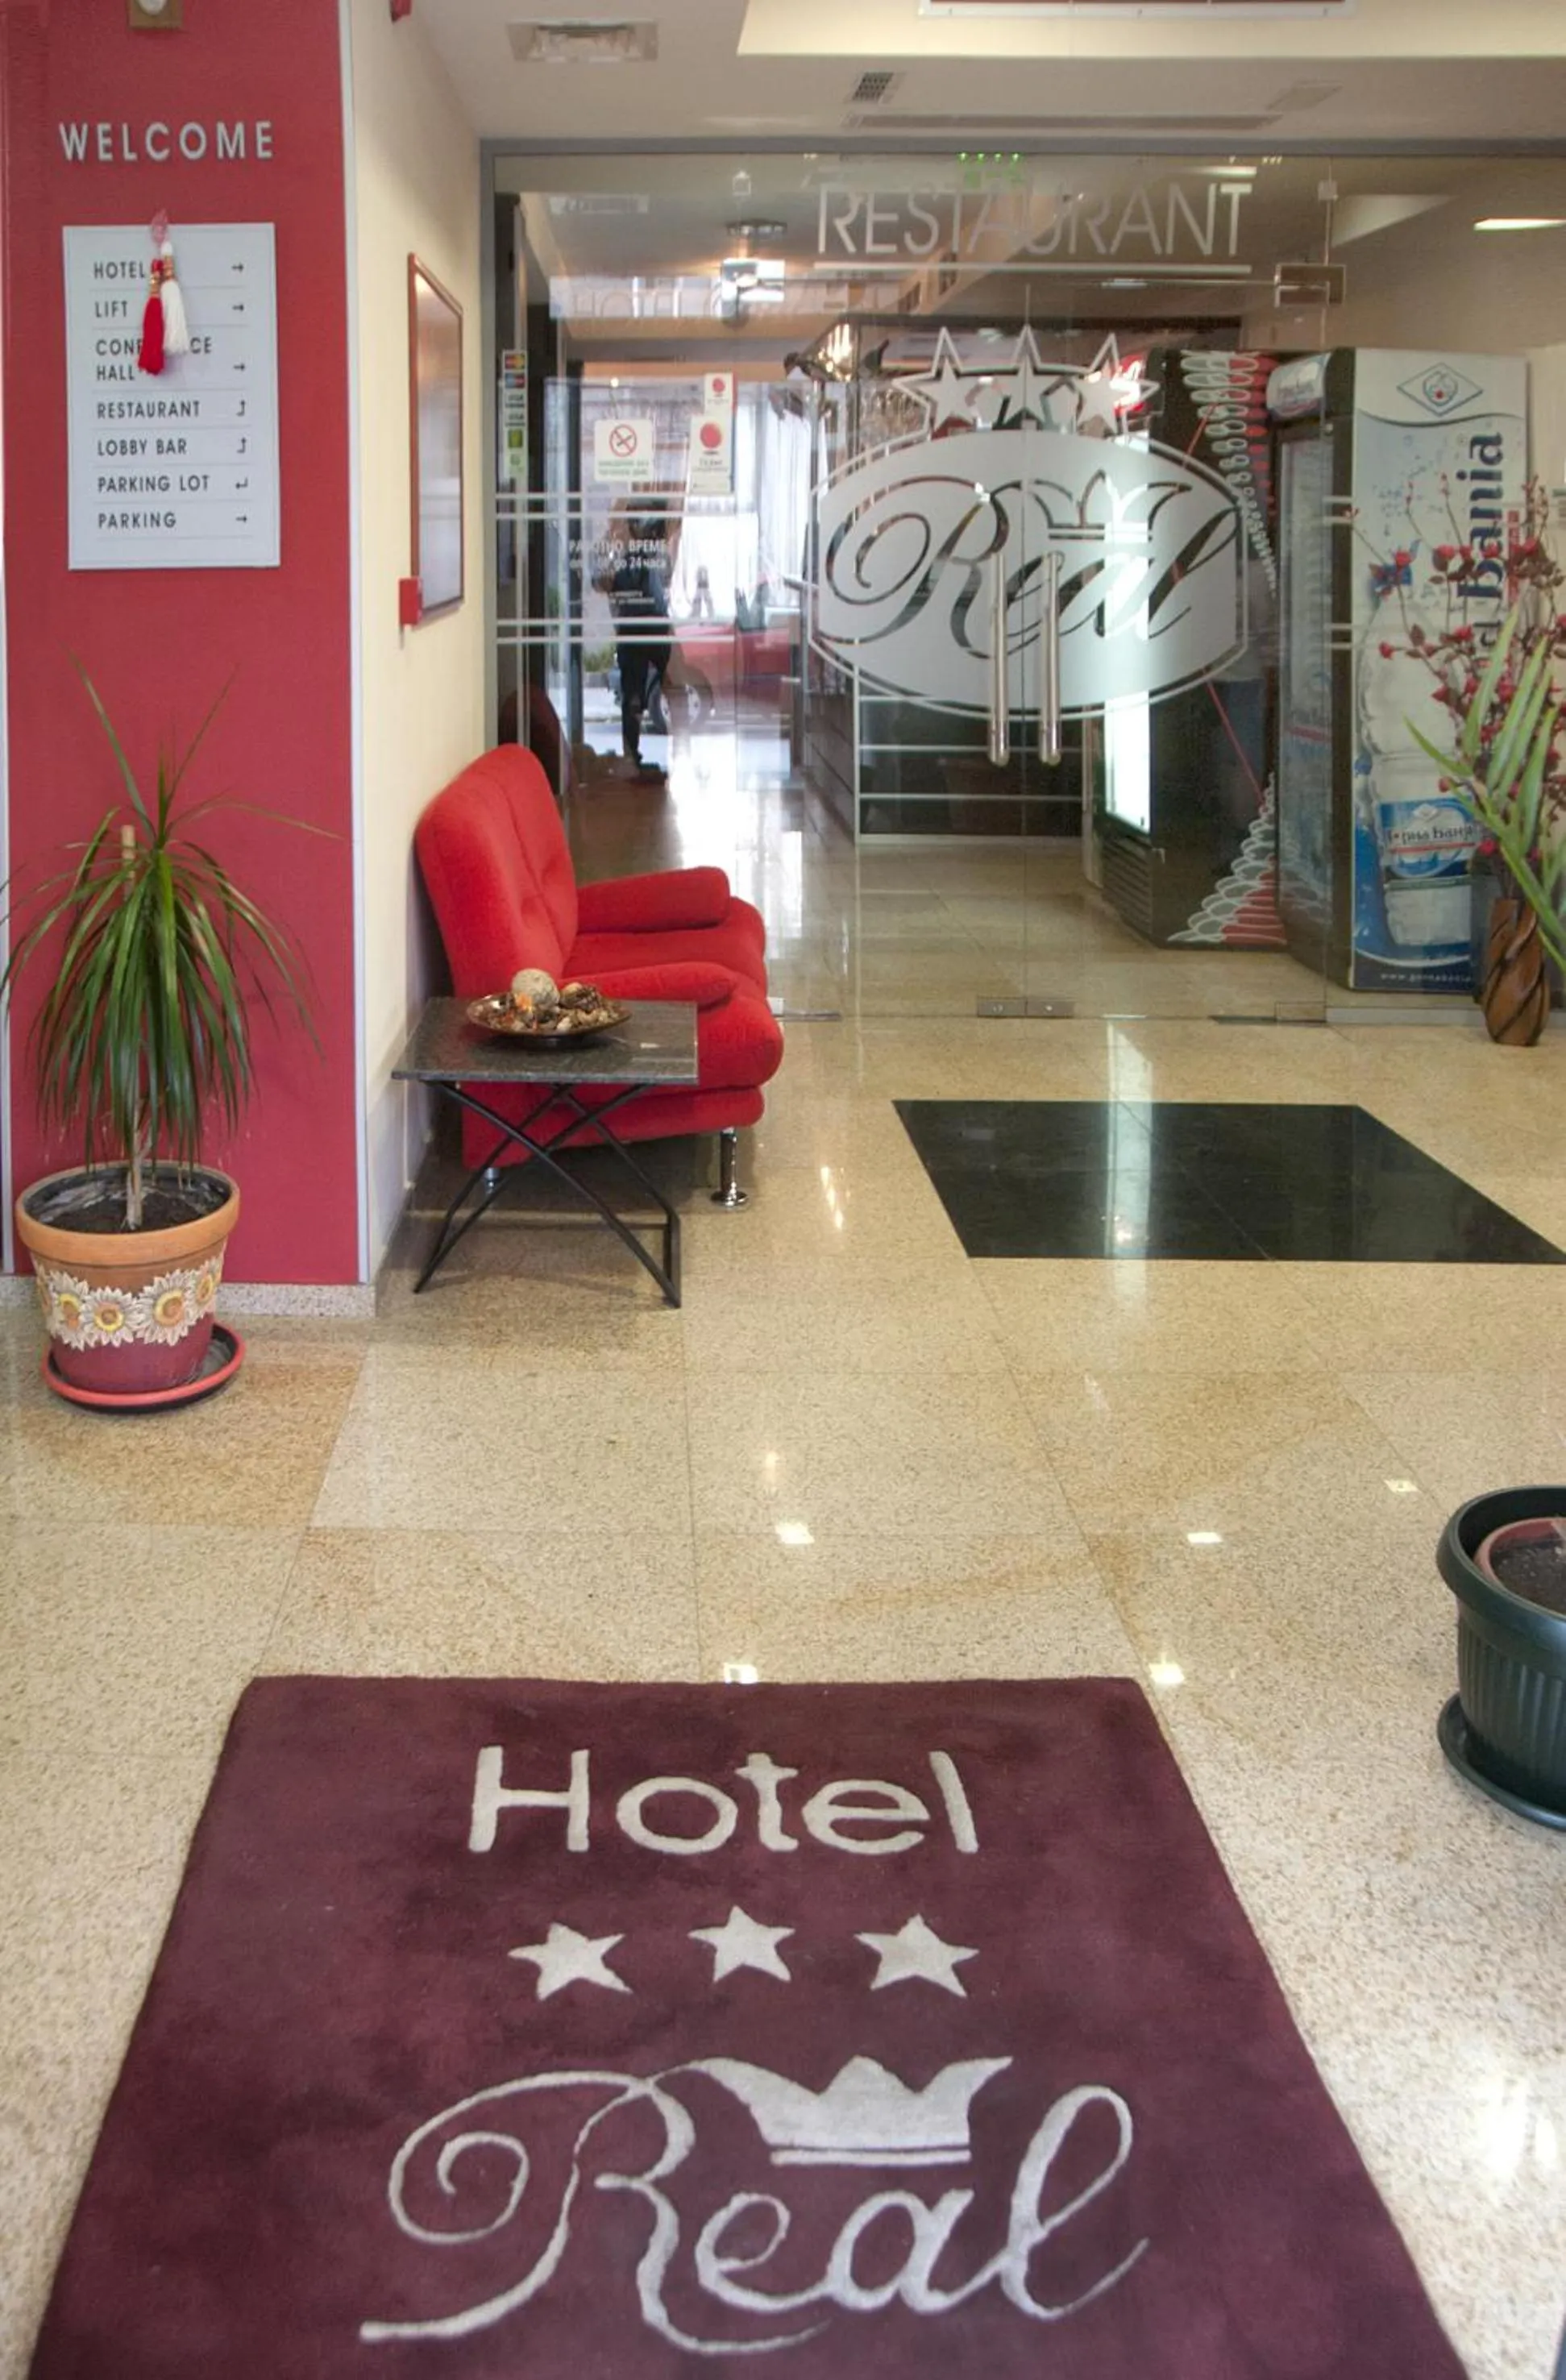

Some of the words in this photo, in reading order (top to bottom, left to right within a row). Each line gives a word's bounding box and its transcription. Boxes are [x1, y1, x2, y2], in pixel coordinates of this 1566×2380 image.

[59, 121, 273, 161] WELCOME
[816, 183, 1252, 256] RESTAURANT
[93, 260, 146, 279] HOTEL
[94, 301, 128, 318] LIFT
[95, 336, 213, 356] CONFCE
[96, 363, 135, 381] HALL
[97, 401, 200, 419] RESTAURANT
[98, 439, 147, 456] LOBBY
[156, 438, 187, 455] BAR
[98, 475, 170, 493] PARKING
[179, 474, 210, 492] LOT
[98, 512, 177, 529] PARKING
[467, 1745, 978, 1856] Hotel
[359, 2068, 1149, 2356] Real
